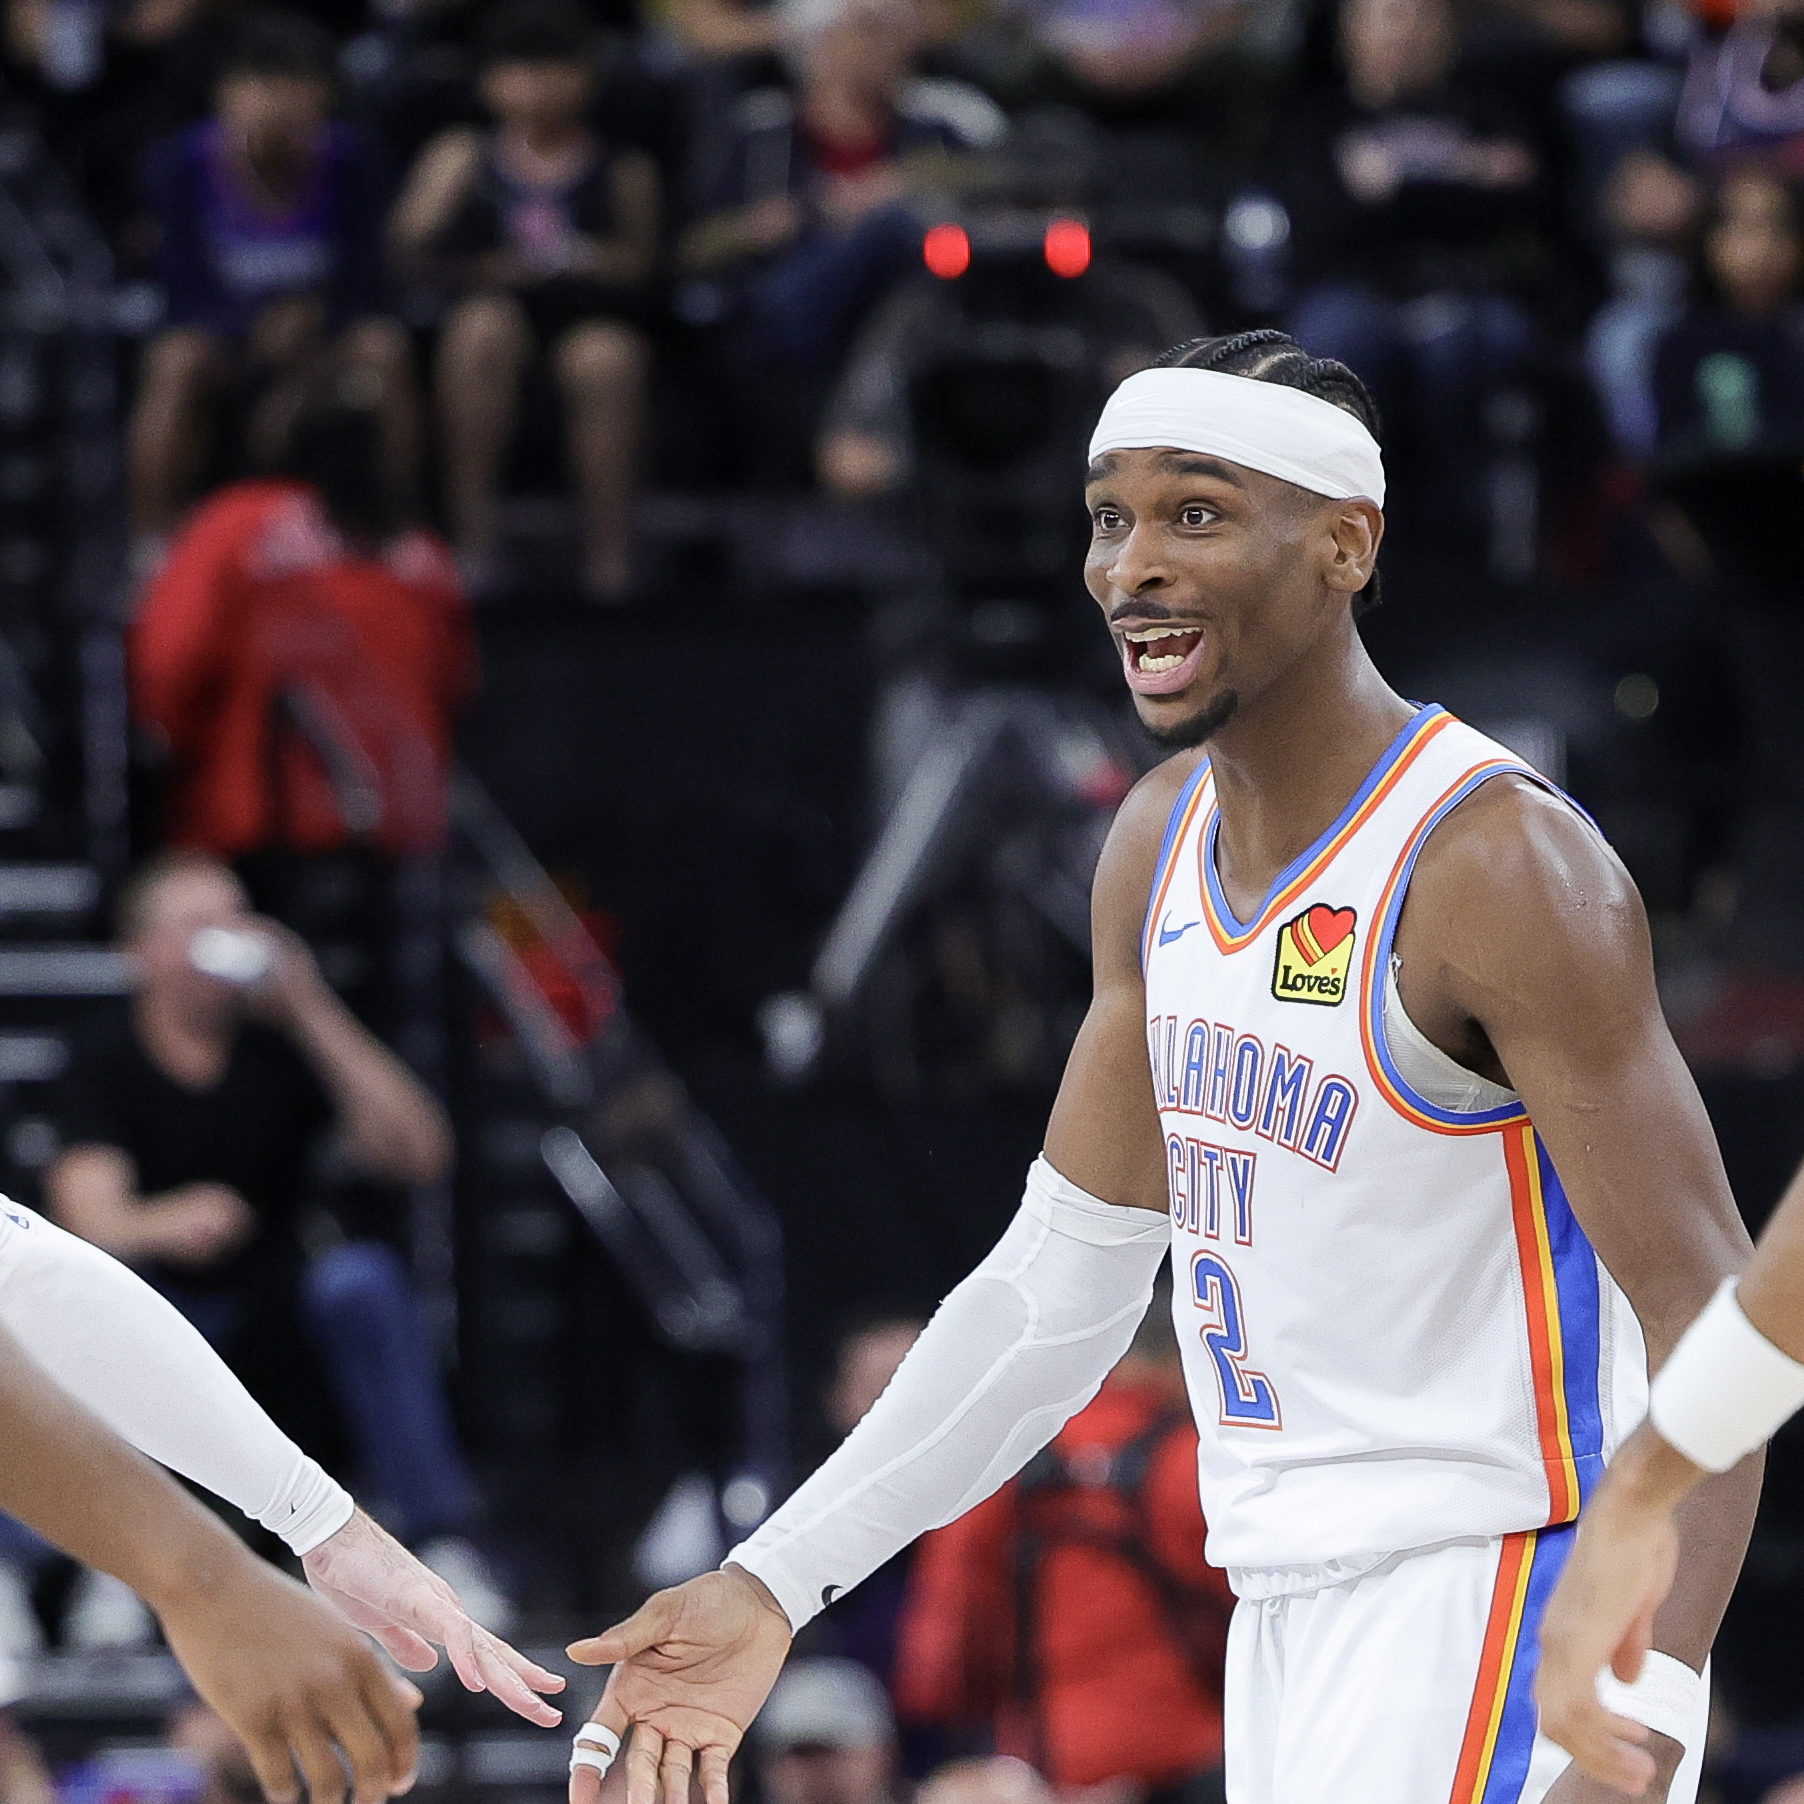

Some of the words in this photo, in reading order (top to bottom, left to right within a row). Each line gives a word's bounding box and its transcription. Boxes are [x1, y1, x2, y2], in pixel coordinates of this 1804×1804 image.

[1279, 964, 1341, 997] Love's
[1166, 1132, 1258, 1247] CITY
[1189, 1249, 1283, 1432] 2
